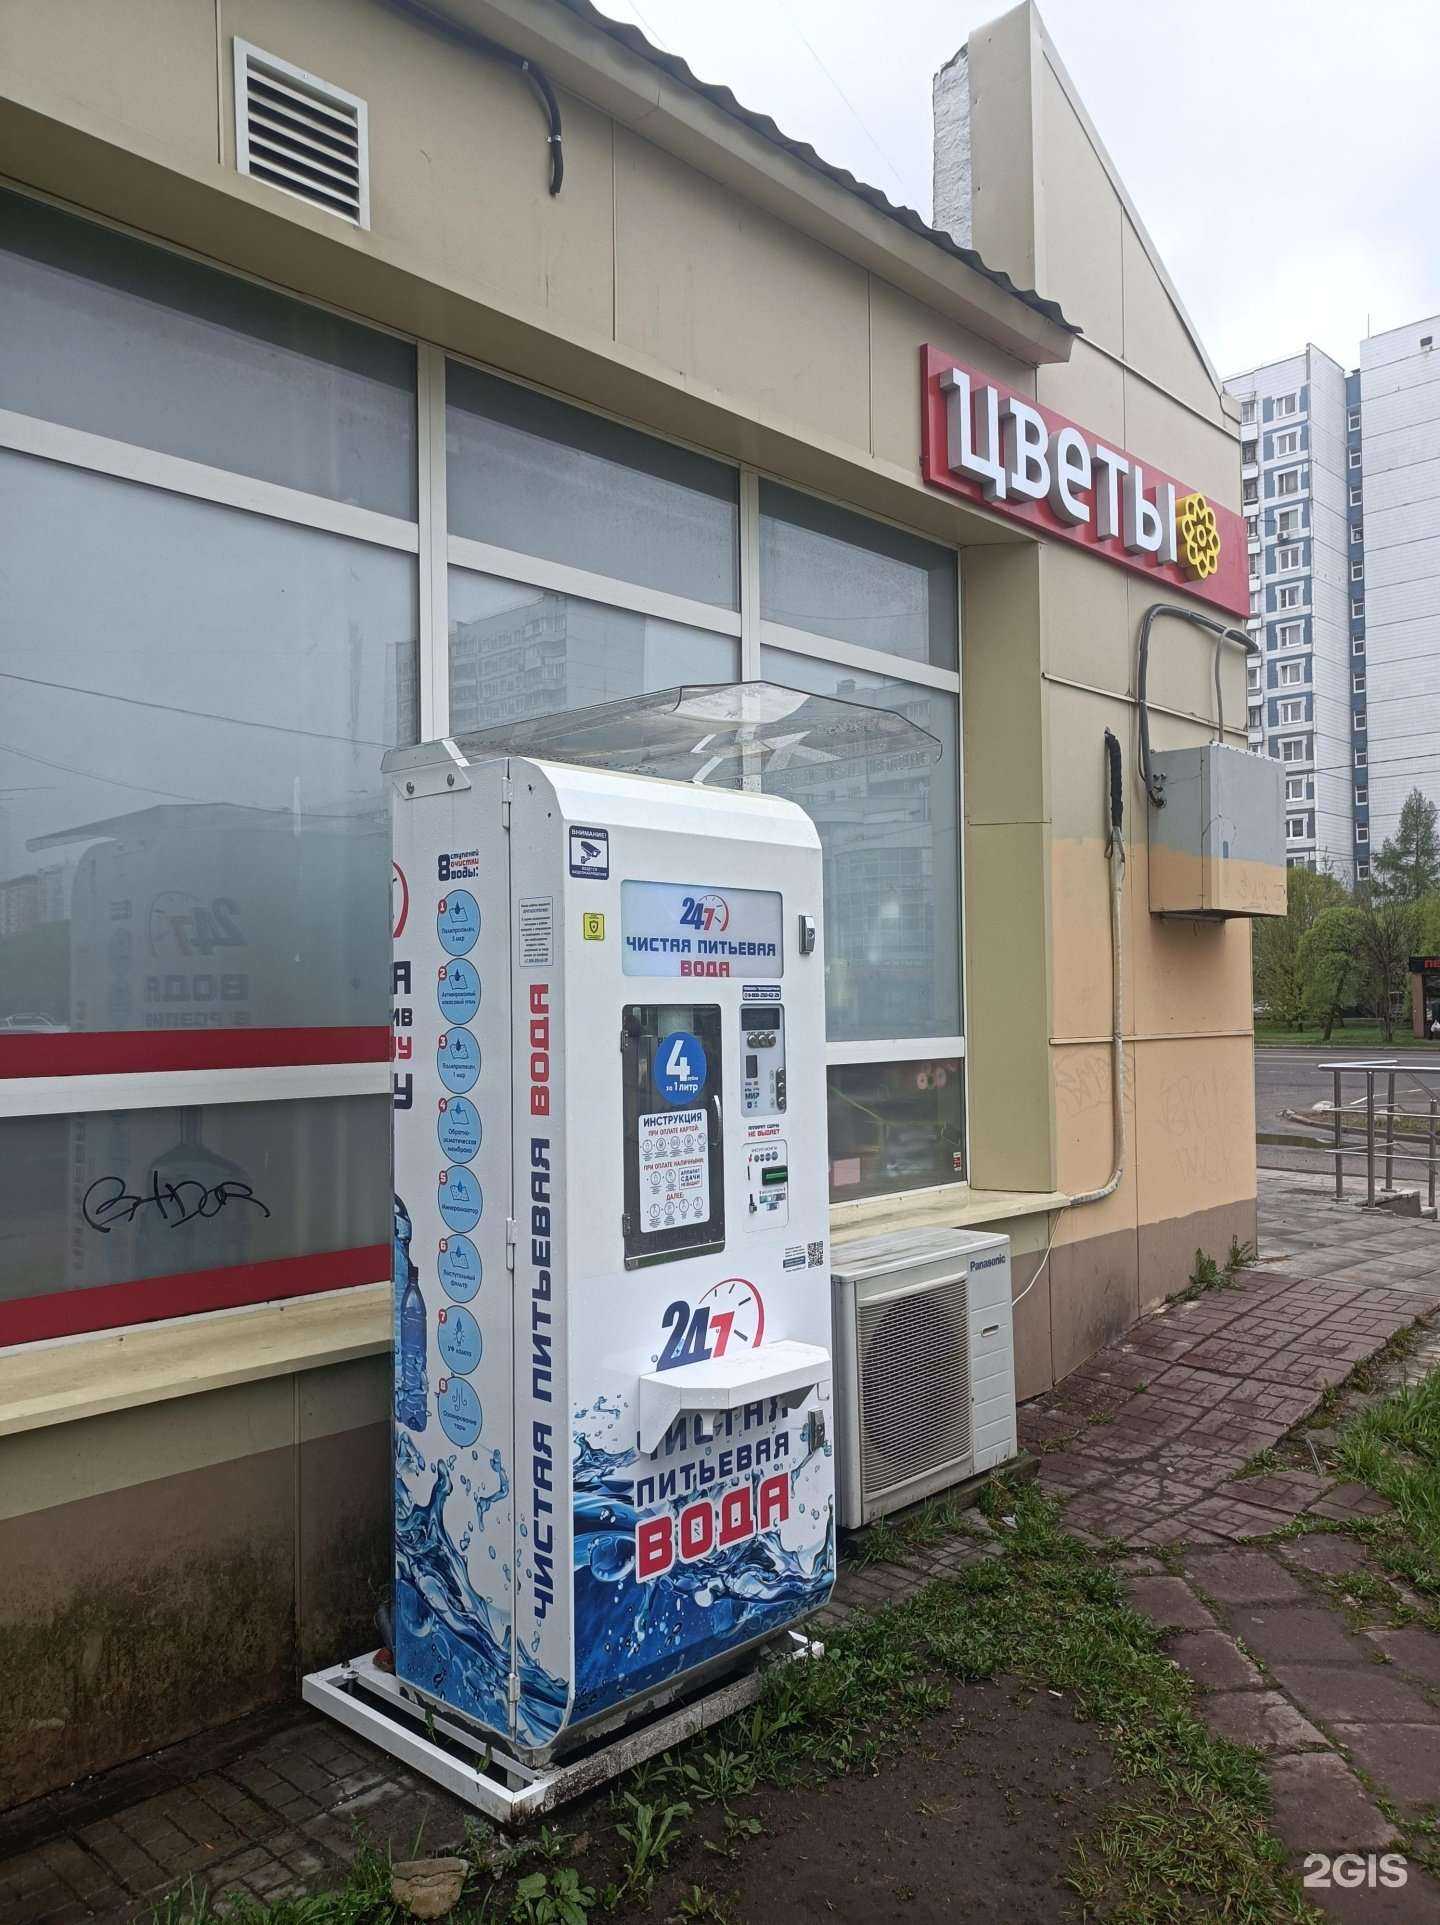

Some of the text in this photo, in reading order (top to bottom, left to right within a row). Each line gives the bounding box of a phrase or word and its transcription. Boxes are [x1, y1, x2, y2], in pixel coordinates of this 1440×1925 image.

[571, 829, 607, 839] ВНИМАНИЕ!
[438, 854, 450, 881] 8
[450, 867, 479, 880] воды:
[626, 936, 776, 957] ЧИСТАЯ ПИТЬЕВАЯ
[680, 959, 730, 977] ВОДА
[529, 983, 550, 1116] ВОДА
[666, 1040, 690, 1081] 4
[679, 1084, 699, 1094] литр
[643, 1111, 703, 1128] ИНСТРУКЦИЯ
[531, 1137, 553, 1403] ПИТЬЕВАЯ
[970, 1253, 1006, 1273] Panasonic
[636, 1431, 789, 1508] ПИТЬЕВАЯ
[532, 1420, 554, 1621] ЧИСТАЯ
[637, 1471, 790, 1579] ВОДА
